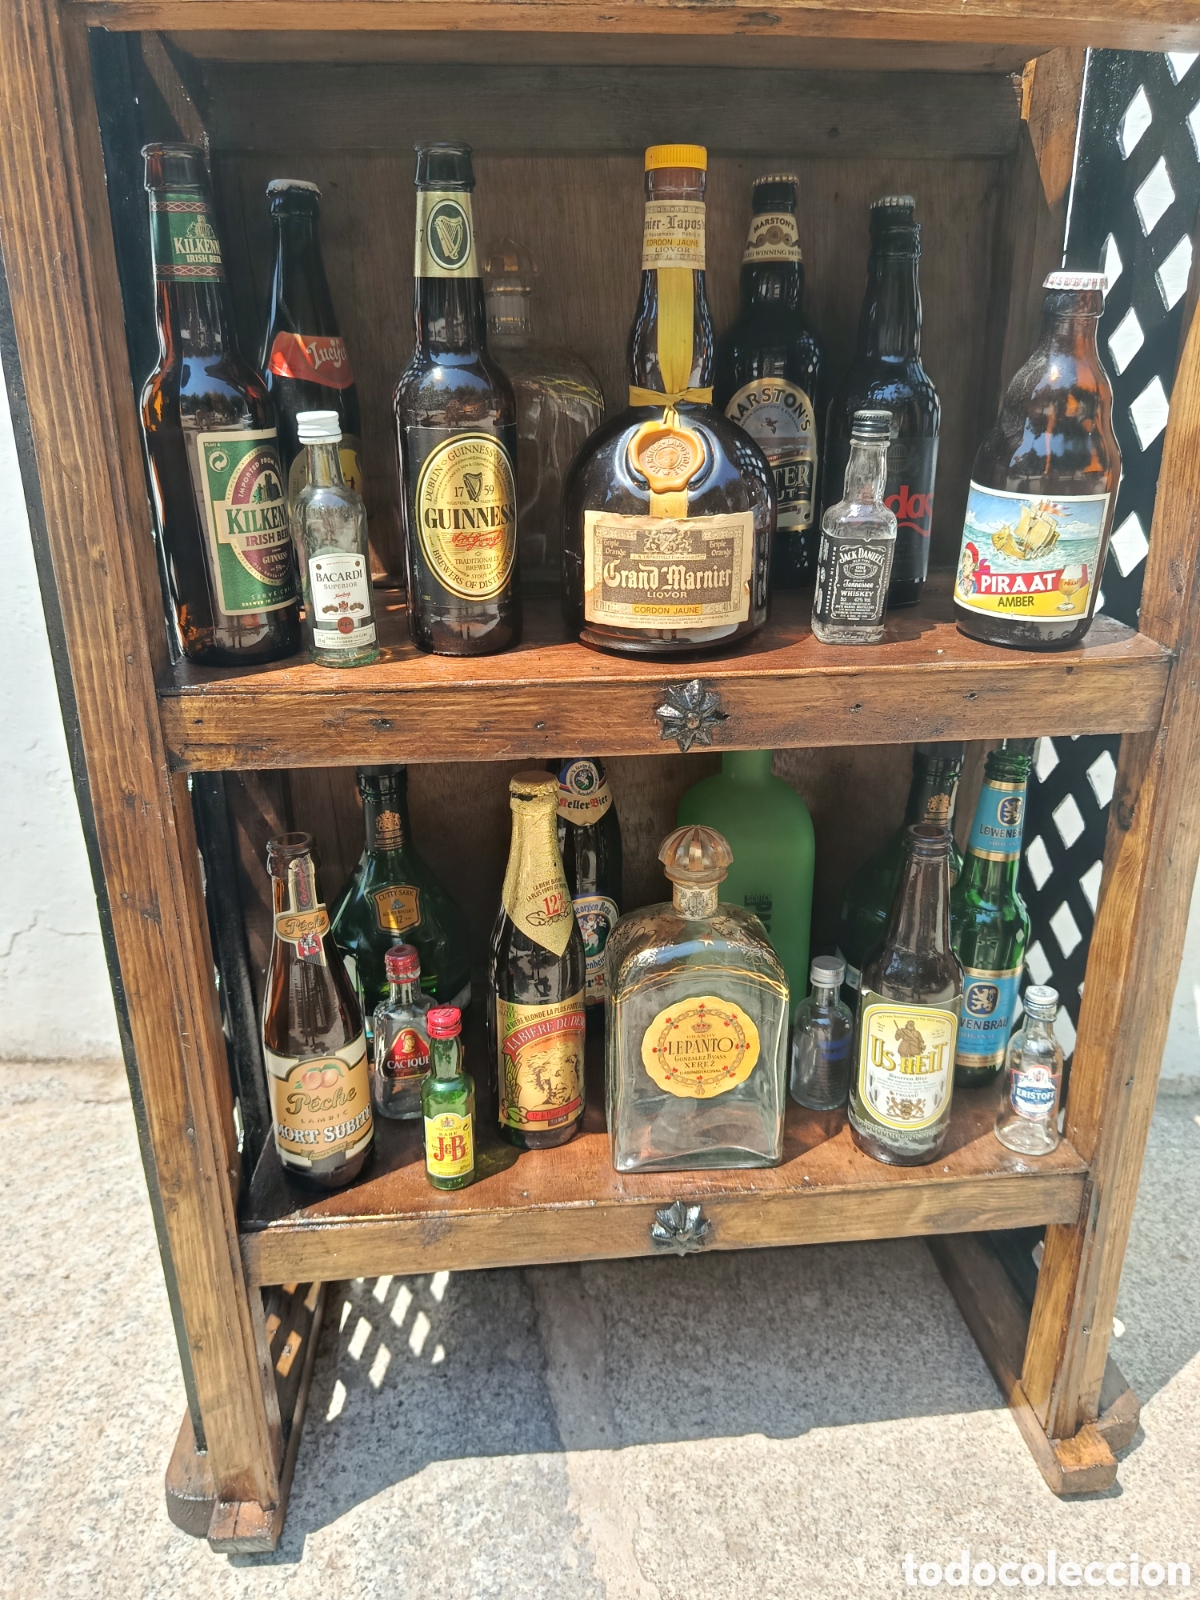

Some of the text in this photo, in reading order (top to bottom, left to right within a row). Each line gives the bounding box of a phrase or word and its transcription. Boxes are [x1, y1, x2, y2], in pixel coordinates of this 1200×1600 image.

[753, 217, 794, 233] MARSTON'S
[646, 239, 699, 248] CORDON JAUNE
[186, 254, 208, 263] IRISH
[238, 461, 260, 498] IMPORTED
[425, 464, 443, 502] DUBLIN
[447, 444, 495, 462] GUINNESS
[772, 464, 810, 488] TER
[454, 484, 495, 498] 17 59
[424, 502, 515, 530] GUINNESS
[245, 532, 275, 547] IRISH
[839, 547, 886, 567] JACK DANIEL'S
[432, 544, 514, 589] BREWERS OF DISTINCTION
[315, 569, 363, 583] BACARDI
[603, 558, 731, 591] Grand Marnier
[323, 582, 358, 590] SUPERIOR
[980, 573, 1057, 593] PIRAAT
[251, 590, 278, 600] SERVE
[647, 591, 688, 599] LIQVOR
[997, 596, 1035, 608] AMBER
[634, 606, 700, 615] CORDON JAUNE
[378, 889, 414, 902] CUTTY SARK
[542, 890, 567, 917] 12%
[395, 915, 403, 924] 12
[524, 1010, 546, 1023] BLONDE
[546, 1008, 554, 1016] LA
[554, 1005, 567, 1014] PLUS
[506, 1036, 521, 1052] LA
[555, 1016, 570, 1029] DU
[668, 1037, 734, 1056] LEPANTO
[674, 1055, 707, 1063] GONZALEZ
[870, 1034, 949, 1075] US HEIT
[386, 1055, 430, 1070] CACIQUE
[684, 1060, 716, 1069] XEREZ
[285, 1086, 358, 1115] Pêche
[1016, 1087, 1055, 1100] ERISTOFF
[300, 1109, 349, 1124] LAMBIC
[310, 1150, 330, 1159] ANNO
[433, 1134, 466, 1162] J&B
